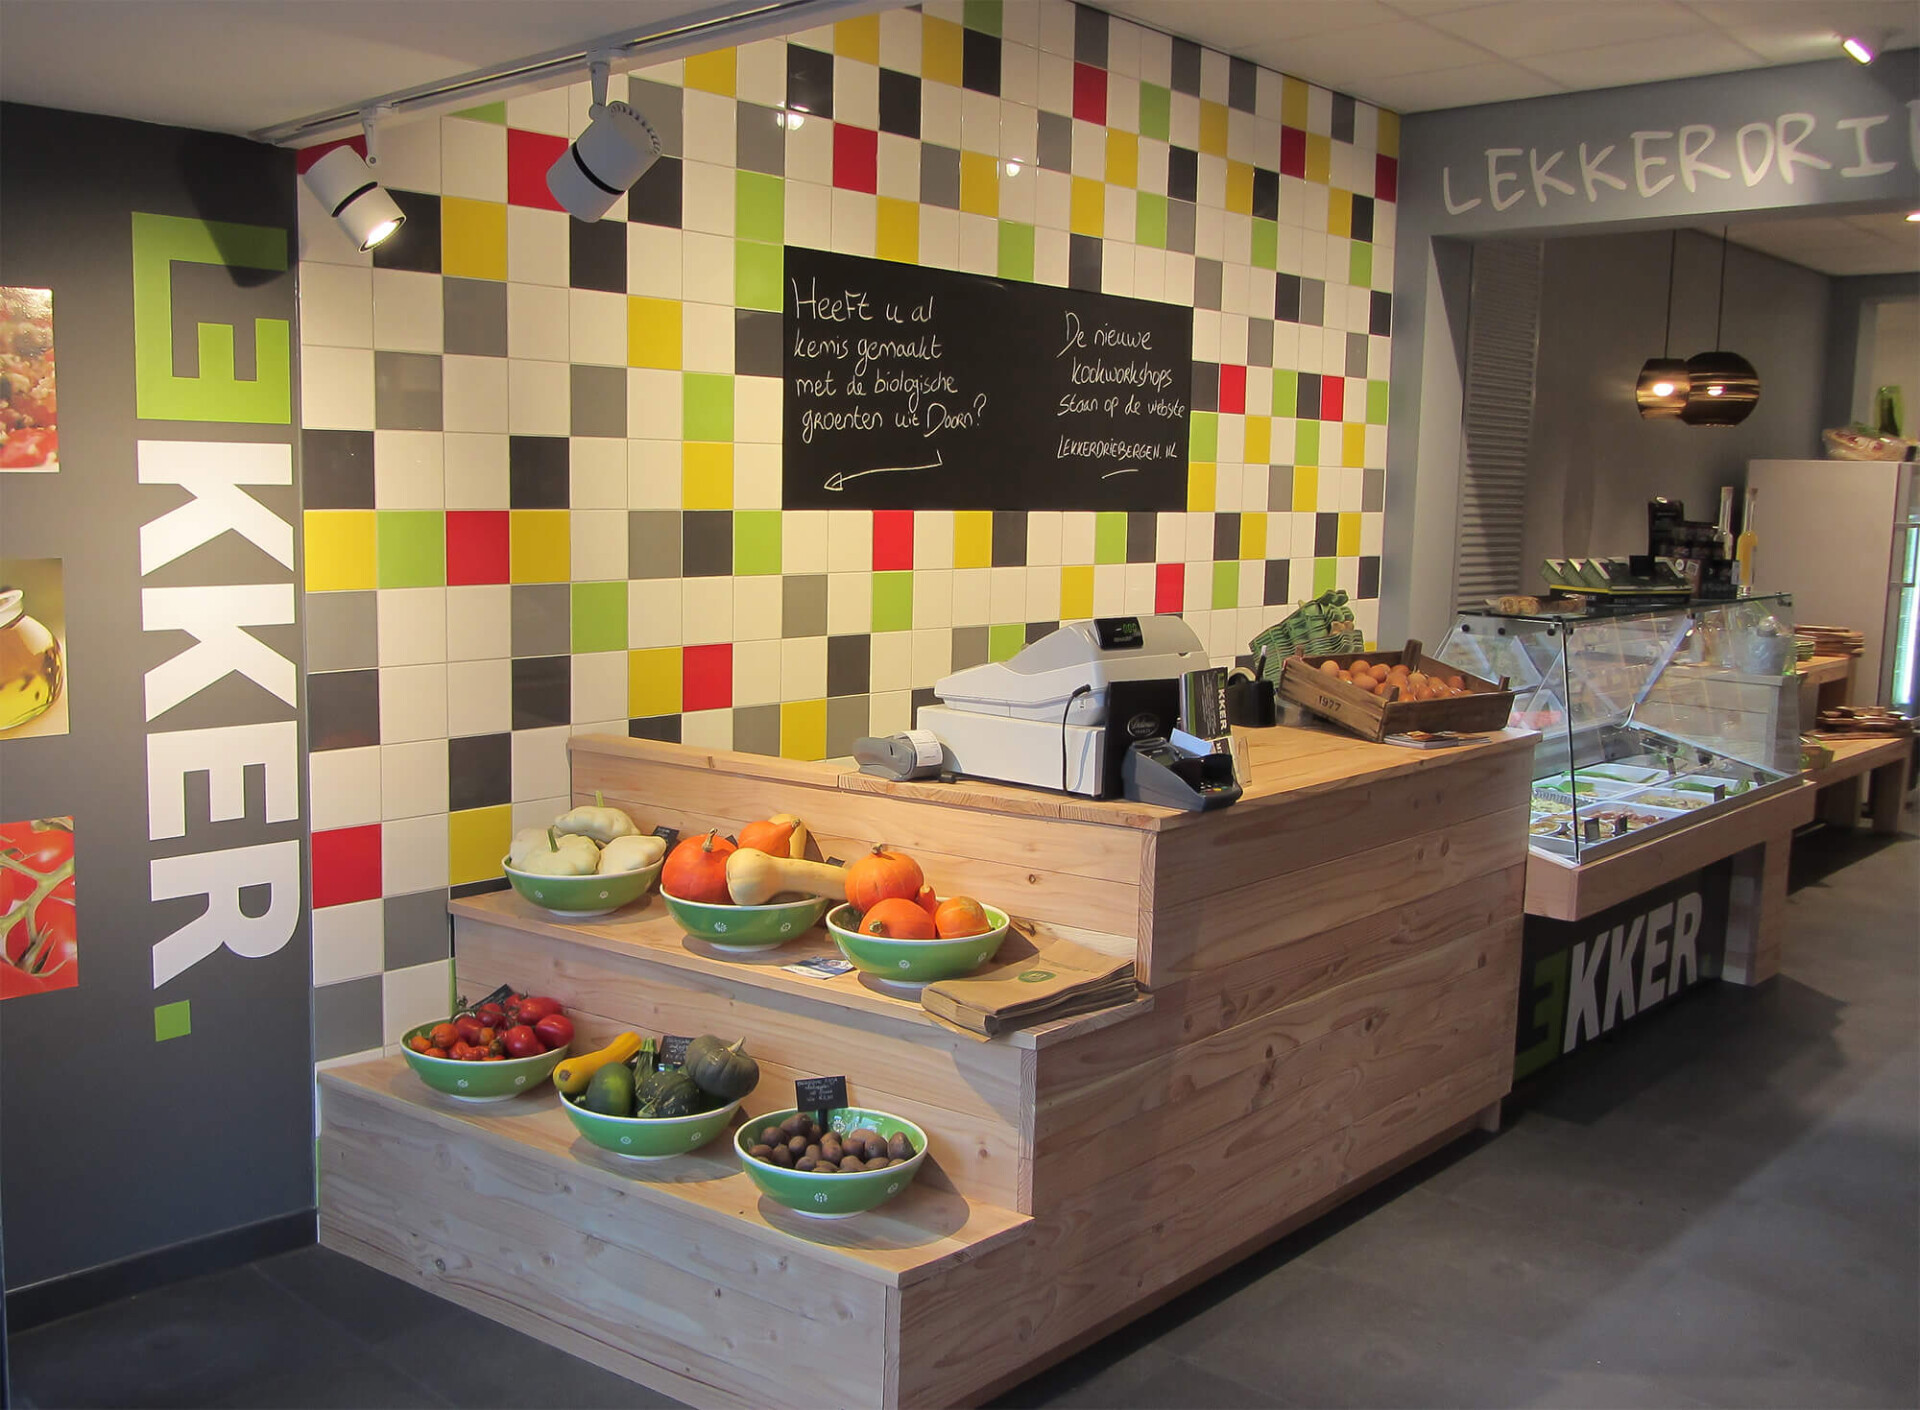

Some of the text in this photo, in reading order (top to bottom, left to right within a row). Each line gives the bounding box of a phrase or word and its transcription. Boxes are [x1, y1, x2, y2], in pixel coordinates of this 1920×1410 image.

[1443, 100, 1920, 216] LEKKERDRI
[886, 303, 904, 323] u
[911, 296, 934, 322] al
[1056, 311, 1152, 358] De nieuwe
[855, 334, 942, 376] gemaakt
[796, 368, 958, 413] met de biologische
[1104, 397, 1119, 418] op
[1124, 394, 1141, 416] de
[802, 405, 883, 444] groenten
[895, 411, 920, 428] uit
[1319, 695, 1342, 712] 1977
